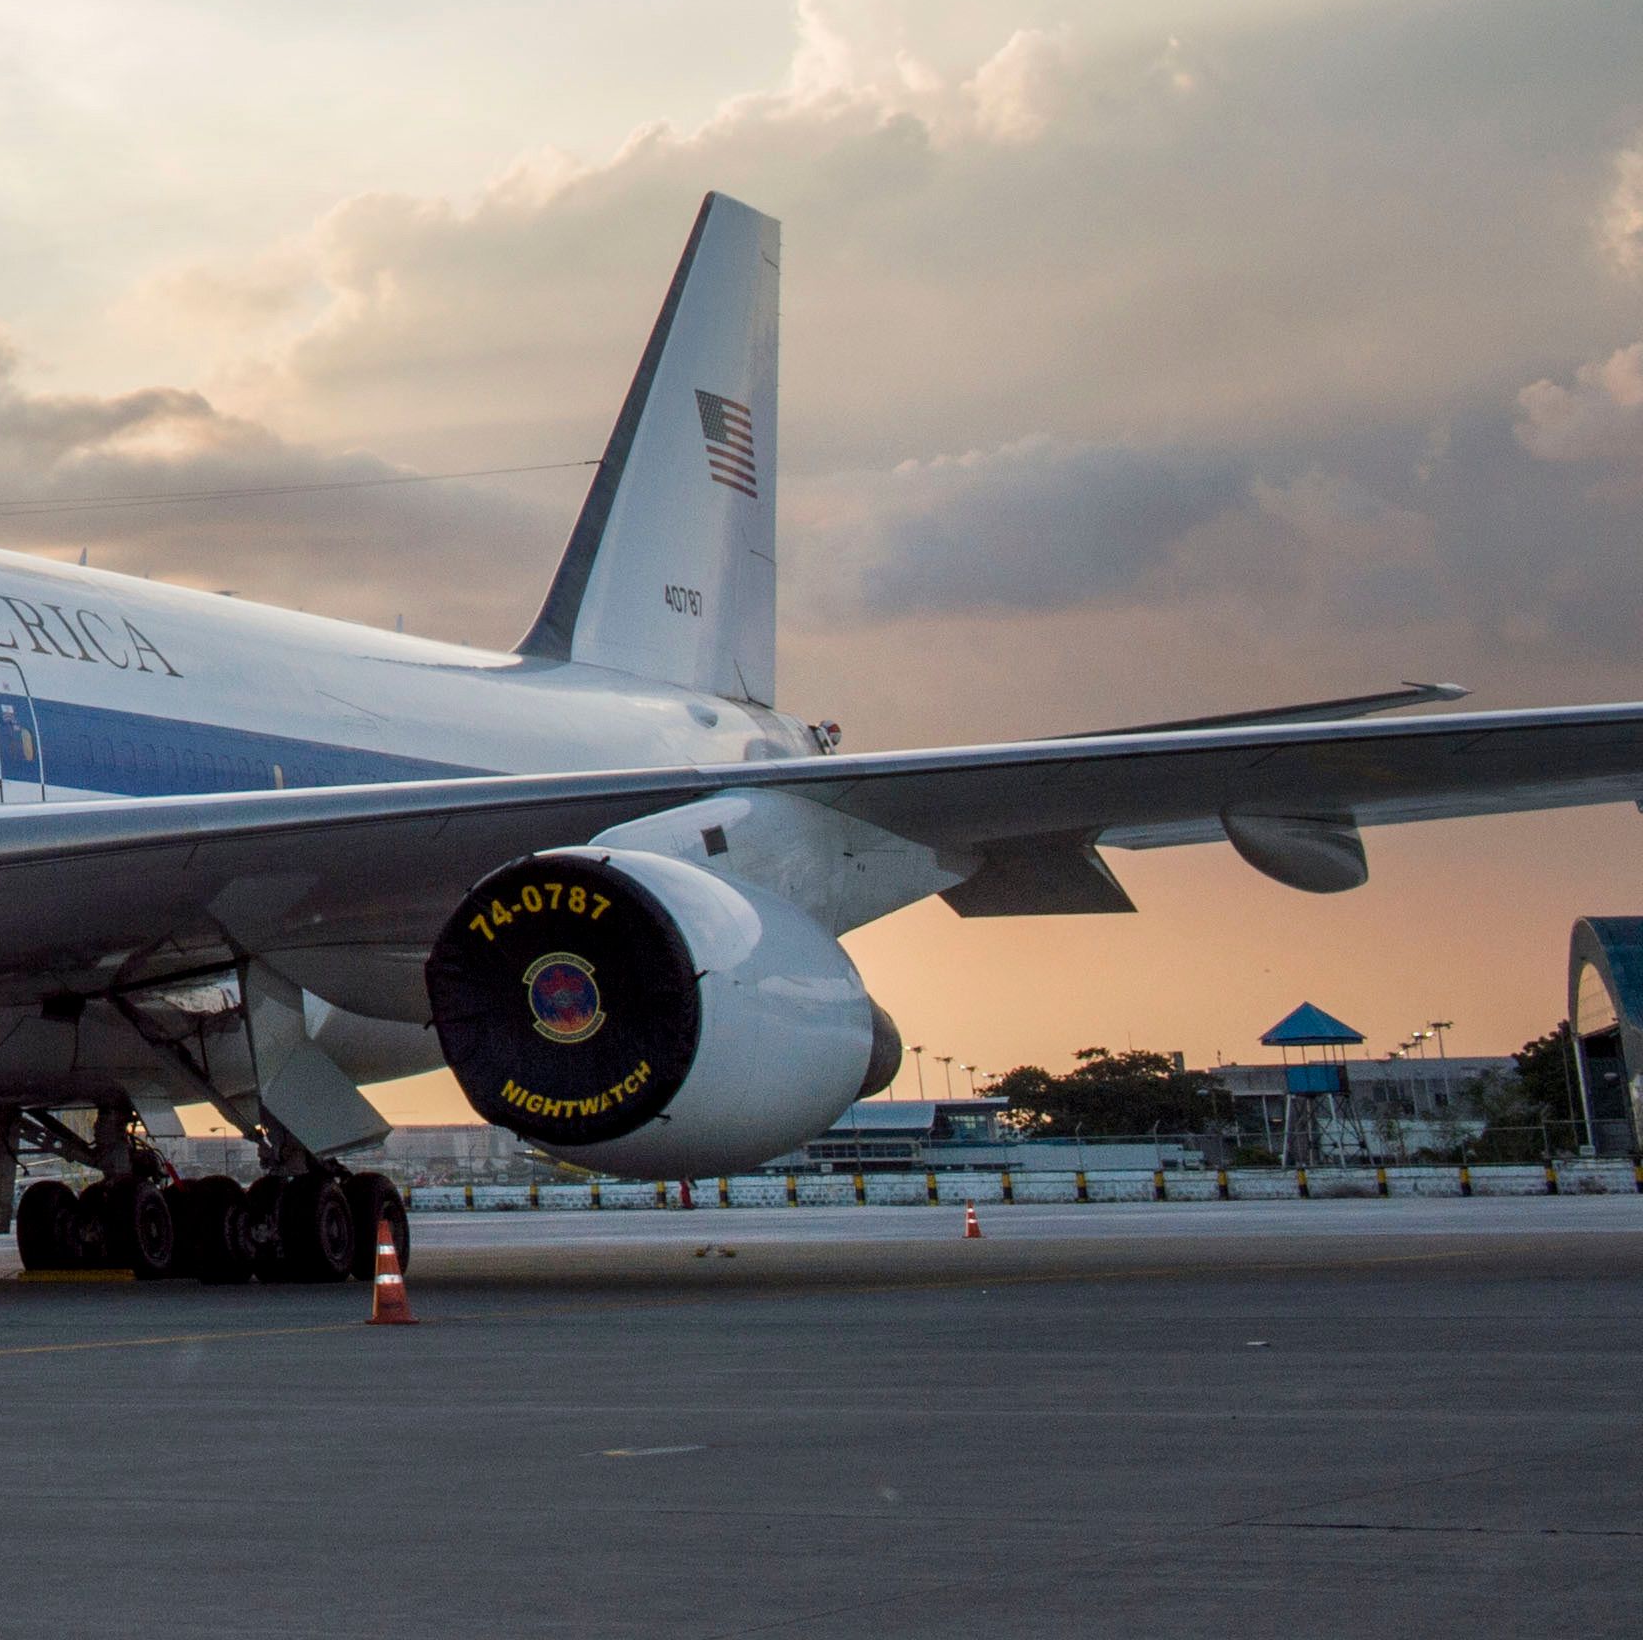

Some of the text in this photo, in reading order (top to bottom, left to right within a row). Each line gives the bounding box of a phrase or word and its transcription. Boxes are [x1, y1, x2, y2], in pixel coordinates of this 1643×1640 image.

[665, 583, 703, 618] 40787
[468, 882, 612, 942] 74-0787
[500, 1060, 653, 1119] NIGHTWATCH
